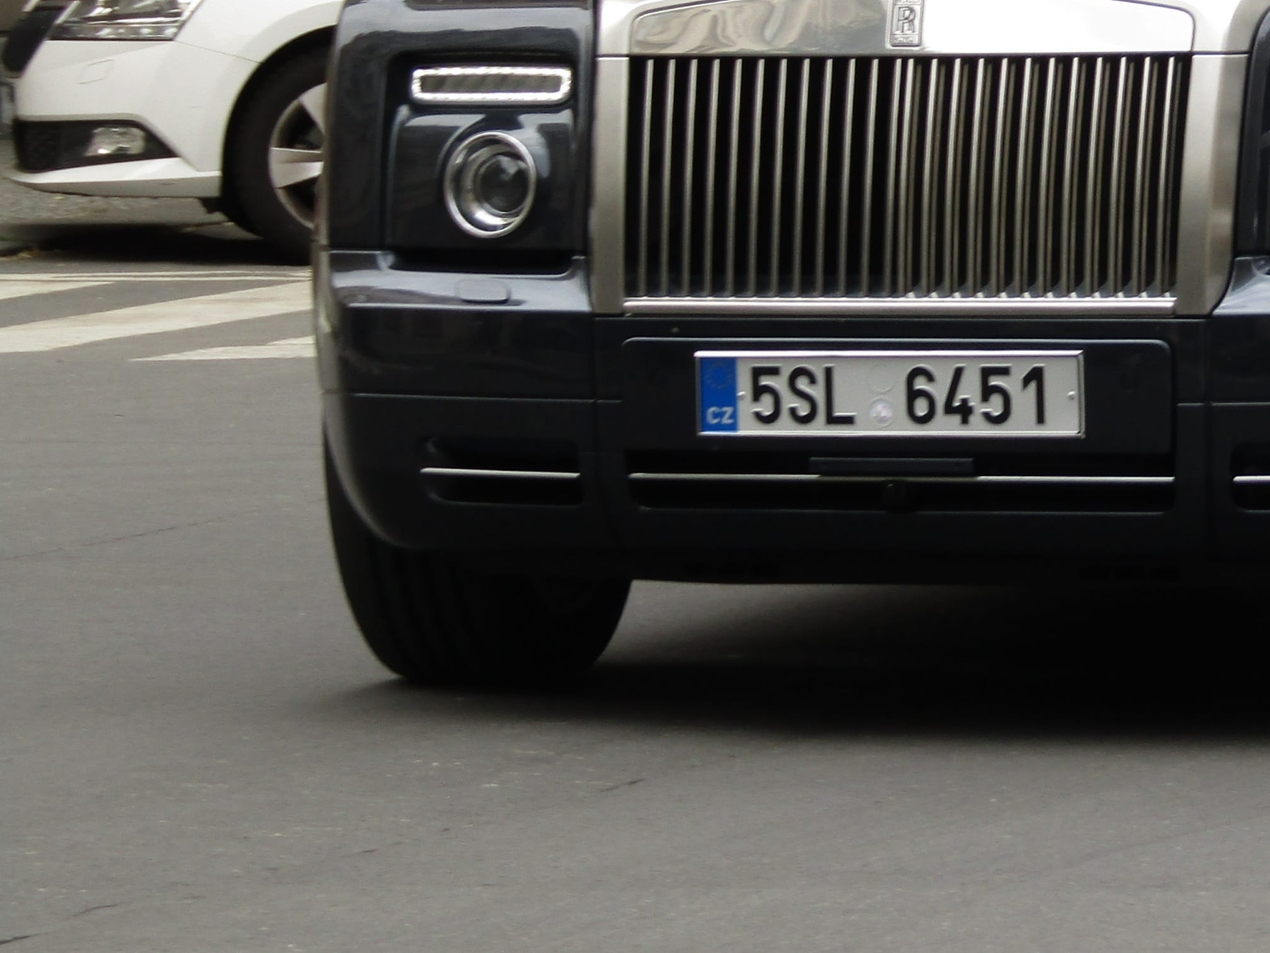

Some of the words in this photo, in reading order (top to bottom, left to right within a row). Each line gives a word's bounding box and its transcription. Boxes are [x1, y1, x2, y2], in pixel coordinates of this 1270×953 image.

[751, 364, 858, 425] 5SL
[905, 364, 1046, 425] 6451
[706, 406, 734, 424] CZ
